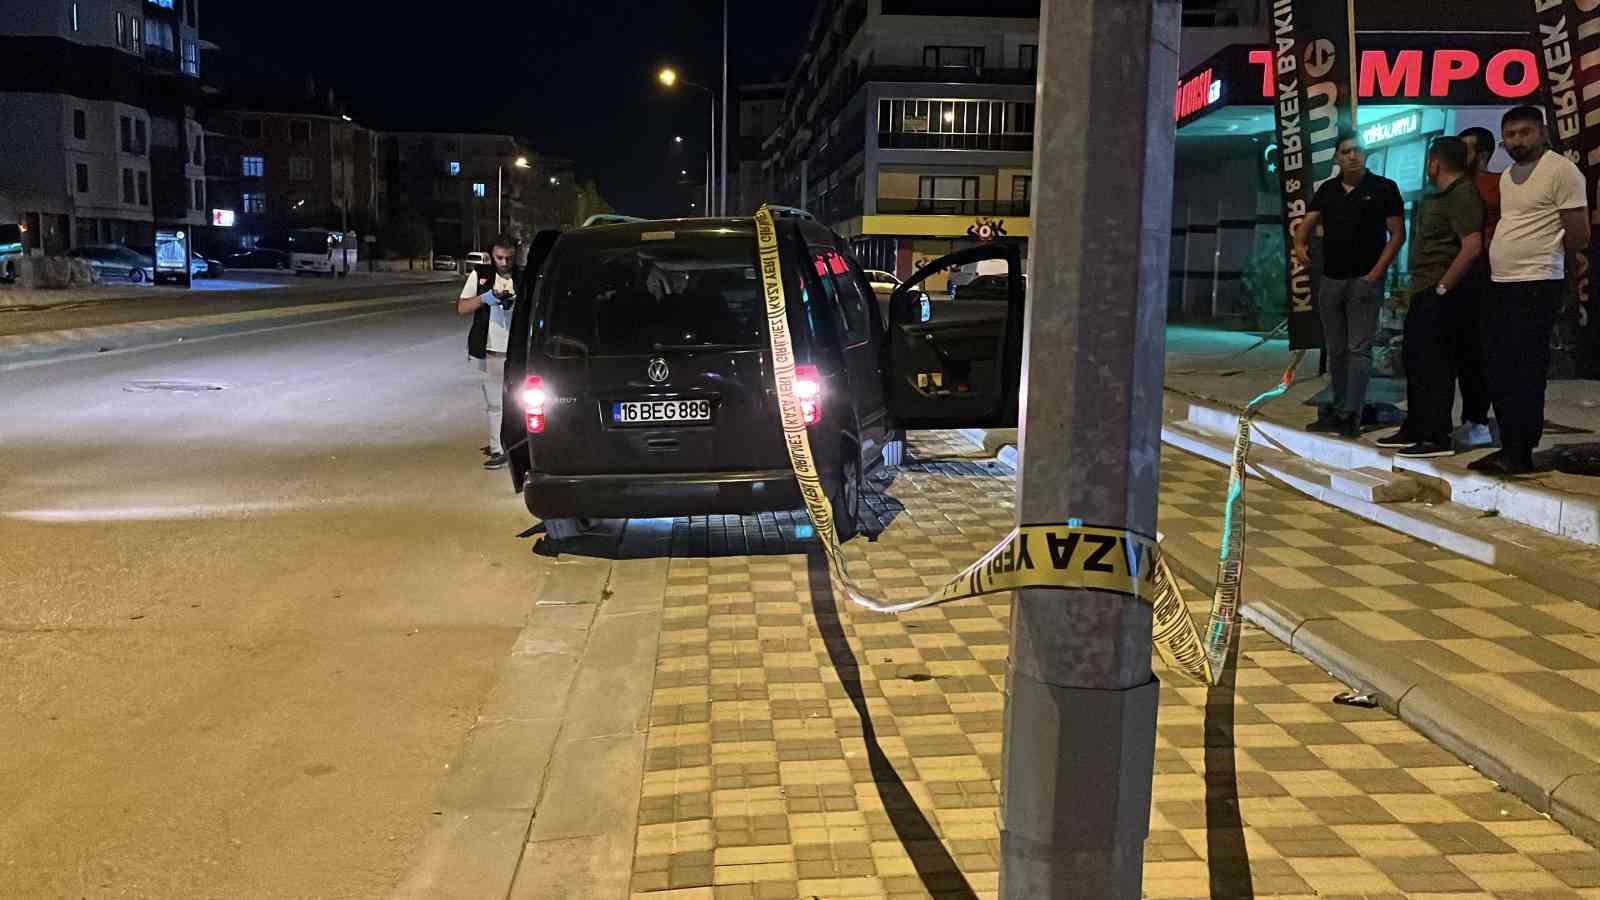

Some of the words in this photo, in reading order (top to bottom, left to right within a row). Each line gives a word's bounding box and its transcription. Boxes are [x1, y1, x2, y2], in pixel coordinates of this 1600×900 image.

[1248, 50, 1541, 98] TMPO
[622, 403, 638, 421] 16
[640, 402, 676, 420] BEG
[679, 401, 709, 418] 889
[1046, 531, 1154, 583] AZA
